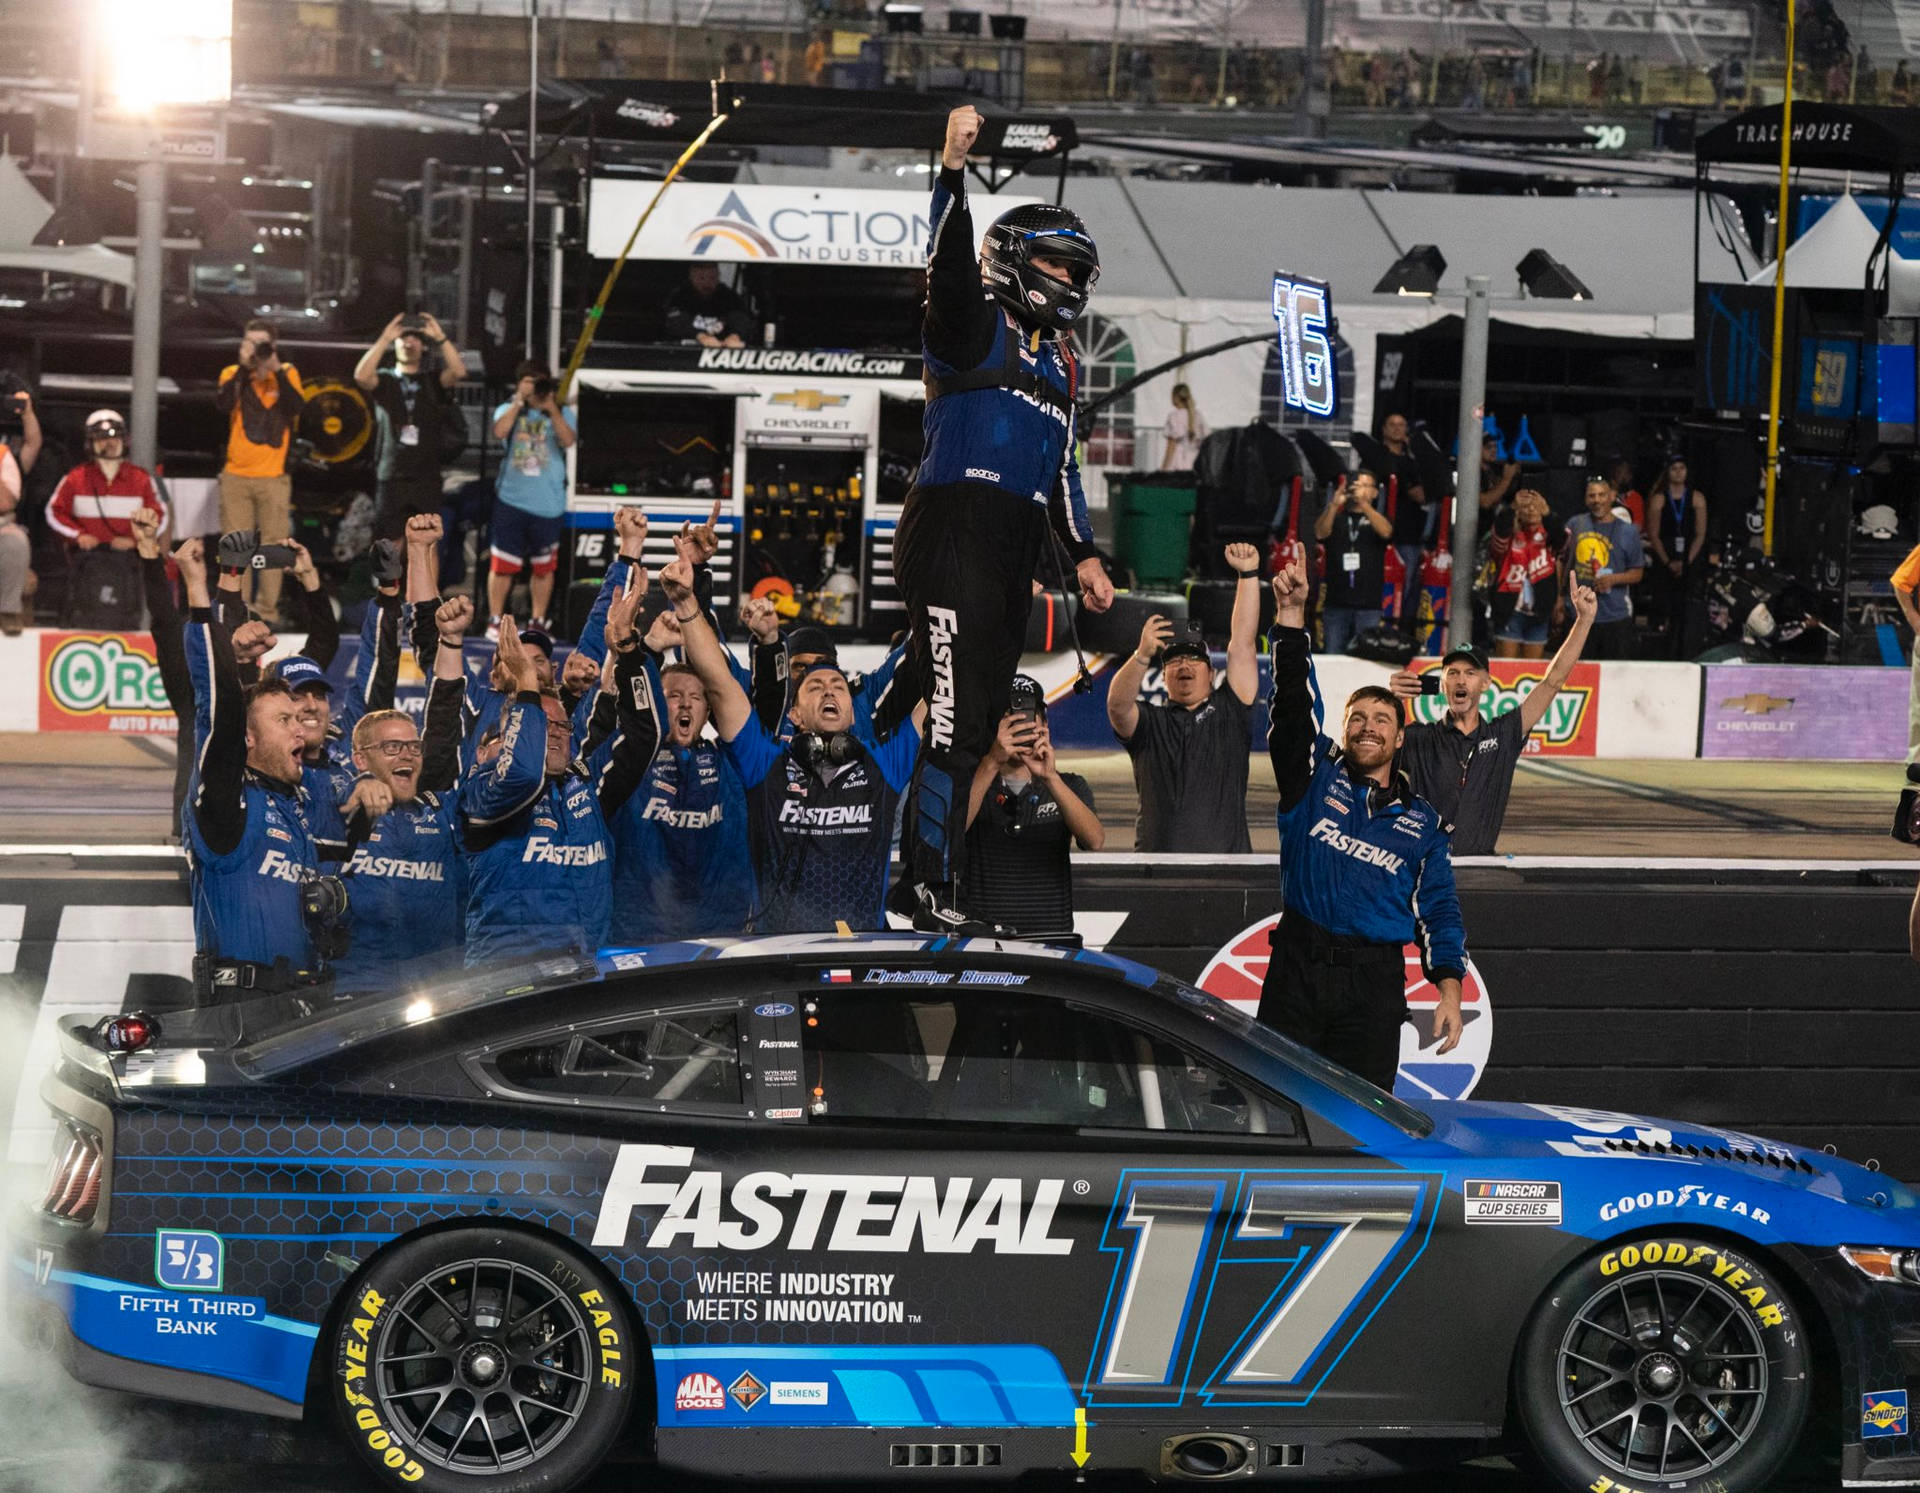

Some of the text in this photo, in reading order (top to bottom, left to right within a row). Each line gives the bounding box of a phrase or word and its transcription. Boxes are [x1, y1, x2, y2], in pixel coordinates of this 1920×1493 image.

[1736, 124, 1852, 142] TRACHOUSE
[786, 246, 929, 264] INDUSTRIE
[1273, 278, 1333, 415] 16
[764, 418, 851, 430] CHEVROLET
[575, 534, 605, 557] 16
[927, 605, 958, 749] FASTENAL
[109, 717, 179, 730] AUTO PAR
[1717, 721, 1796, 732] CHEVROLET
[779, 800, 872, 826] FASTENAL
[1309, 817, 1404, 876] FASTENAL
[341, 849, 444, 881] FASTENAL
[759, 1040, 799, 1049] FASTENAL
[591, 1144, 1075, 1256] FASTENAL
[1495, 1184, 1546, 1198] NASCAR
[1478, 1203, 1548, 1215] CUP SERIES
[1600, 1185, 1771, 1226] GOODYEAR
[34, 1249, 54, 1286] 17
[697, 1272, 895, 1297] WHERE INDUSTRY
[1097, 1180, 1429, 1384] 17
[1600, 1243, 1784, 1330] GOODYEAR
[119, 1295, 256, 1317] FIFTH THIRD
[686, 1299, 757, 1322] MEETS
[764, 1300, 904, 1324] INNOVATION
[156, 1317, 217, 1336] BANK
[578, 1288, 622, 1389] EAGLE
[344, 1289, 425, 1482] GOODYEAR
[677, 1374, 724, 1399] MAC
[777, 1389, 821, 1398] SIEMENS
[677, 1398, 724, 1409] TOOLS
[1864, 1408, 1904, 1422] SUNOCO
